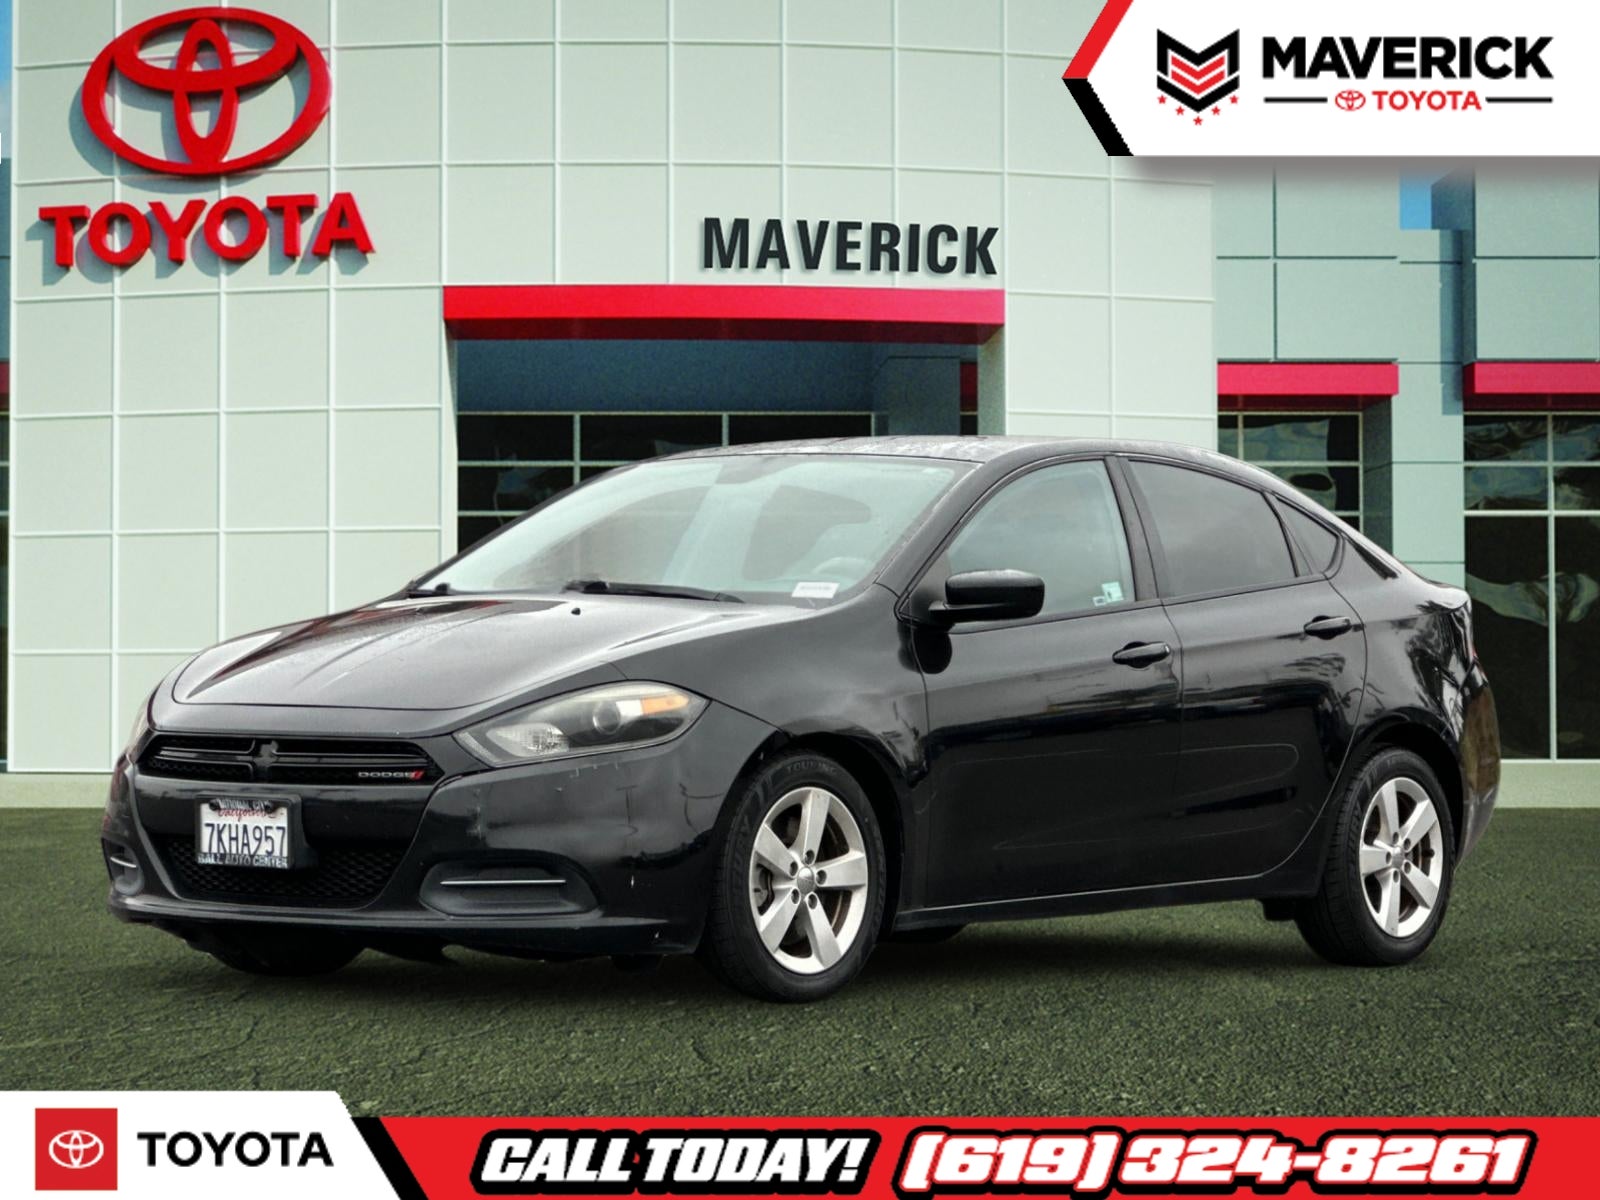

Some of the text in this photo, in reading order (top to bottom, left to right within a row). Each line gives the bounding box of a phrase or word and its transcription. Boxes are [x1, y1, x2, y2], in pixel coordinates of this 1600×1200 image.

[38, 192, 376, 268] TOYOTA
[703, 217, 999, 275] MAVERICK
[204, 823, 286, 858] 7KHA957
